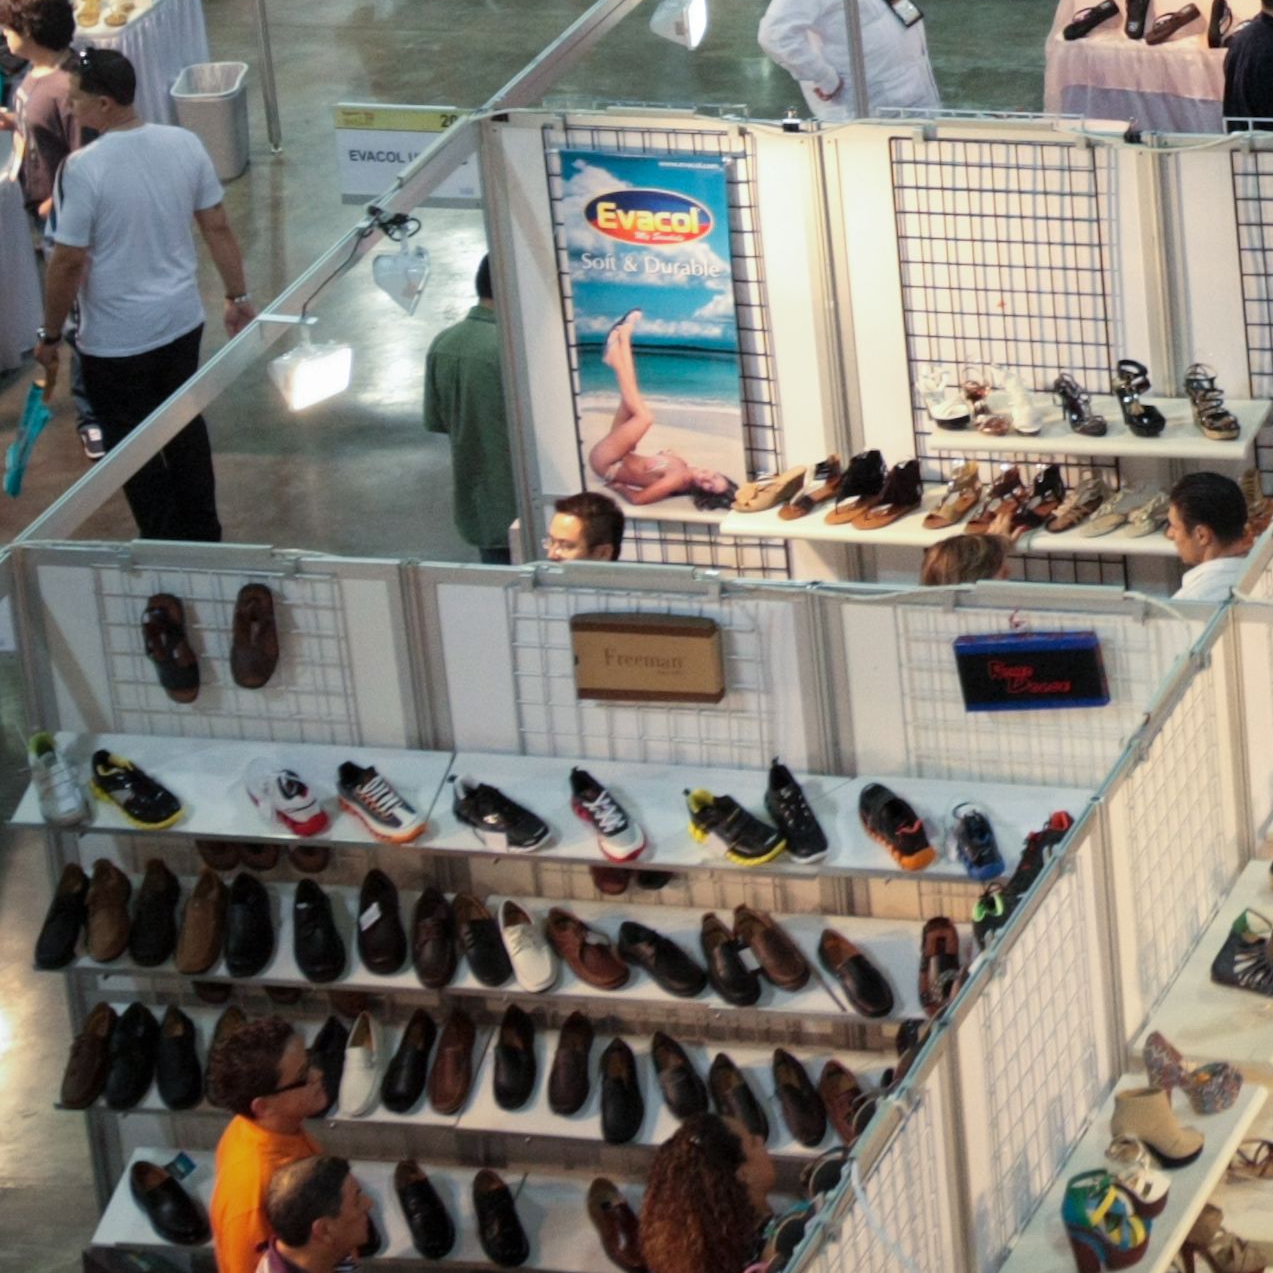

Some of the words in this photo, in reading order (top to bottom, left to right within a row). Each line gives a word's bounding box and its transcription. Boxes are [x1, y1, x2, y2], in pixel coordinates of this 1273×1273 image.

[349, 149, 407, 163] EVACOL
[596, 201, 700, 235] Evacol
[581, 252, 617, 272] Soft
[623, 253, 638, 273] &
[643, 256, 721, 278] Durable
[604, 647, 682, 669] Freeman
